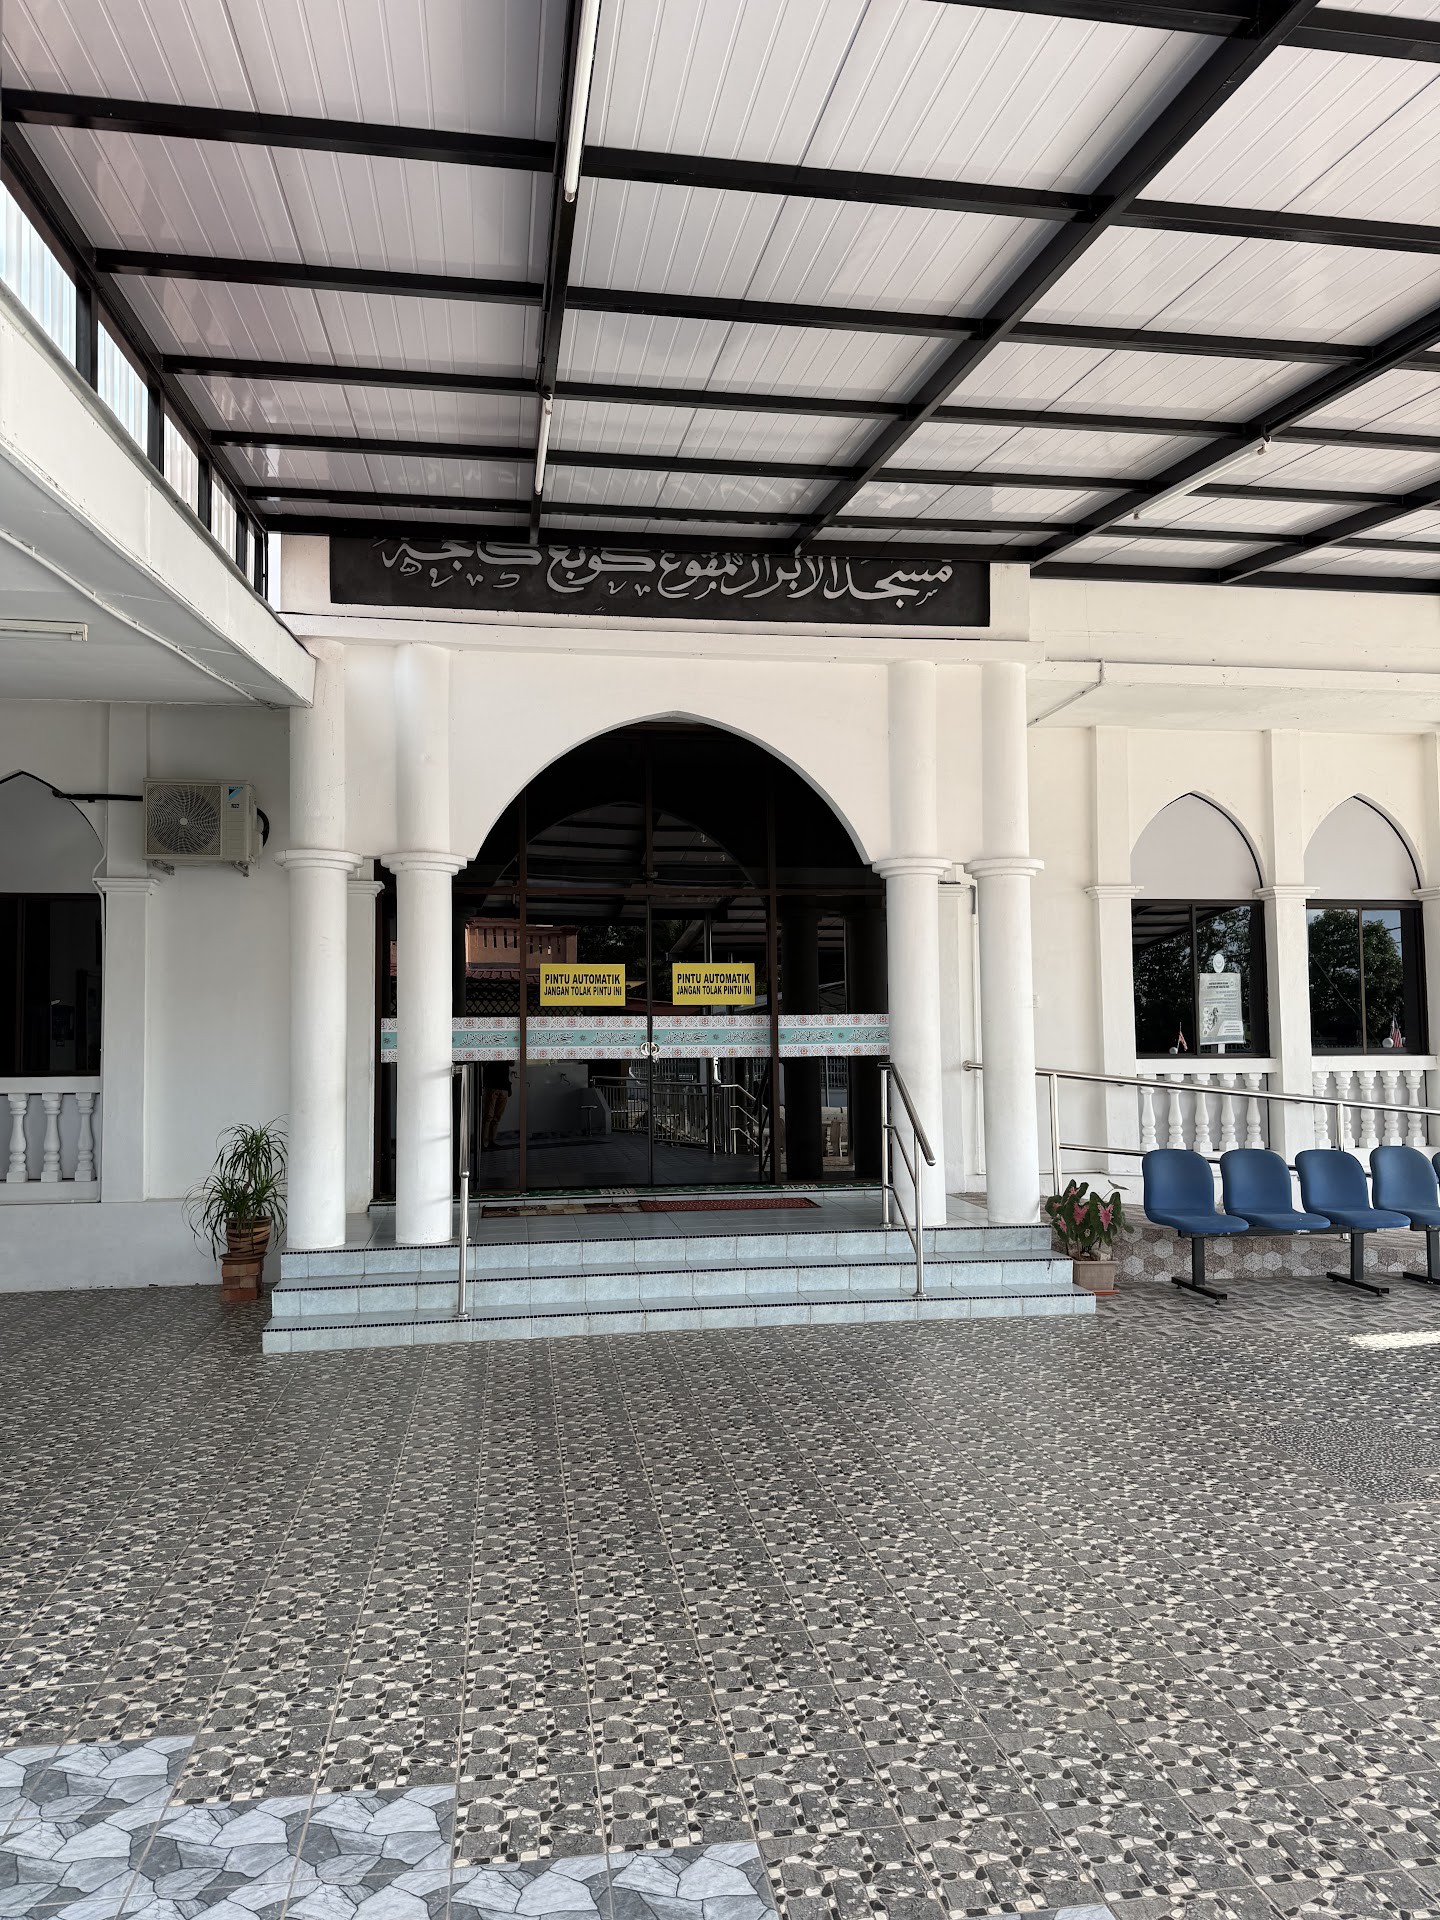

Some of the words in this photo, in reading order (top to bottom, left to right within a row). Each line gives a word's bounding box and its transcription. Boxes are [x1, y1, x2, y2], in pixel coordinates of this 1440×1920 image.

[545, 974, 570, 984] PINTU
[572, 974, 621, 984] AUTOMATIK
[677, 973, 702, 984] PINTU
[703, 973, 751, 984] AUTOMATIK
[544, 986, 570, 996] JANGAN
[571, 986, 592, 996] TOLAK
[593, 986, 612, 996] PINTU
[613, 986, 622, 996] INI
[676, 985, 701, 995] JANGAN
[702, 985, 722, 995] TOLAK
[723, 985, 742, 995] PINTU
[743, 985, 752, 995] INI
